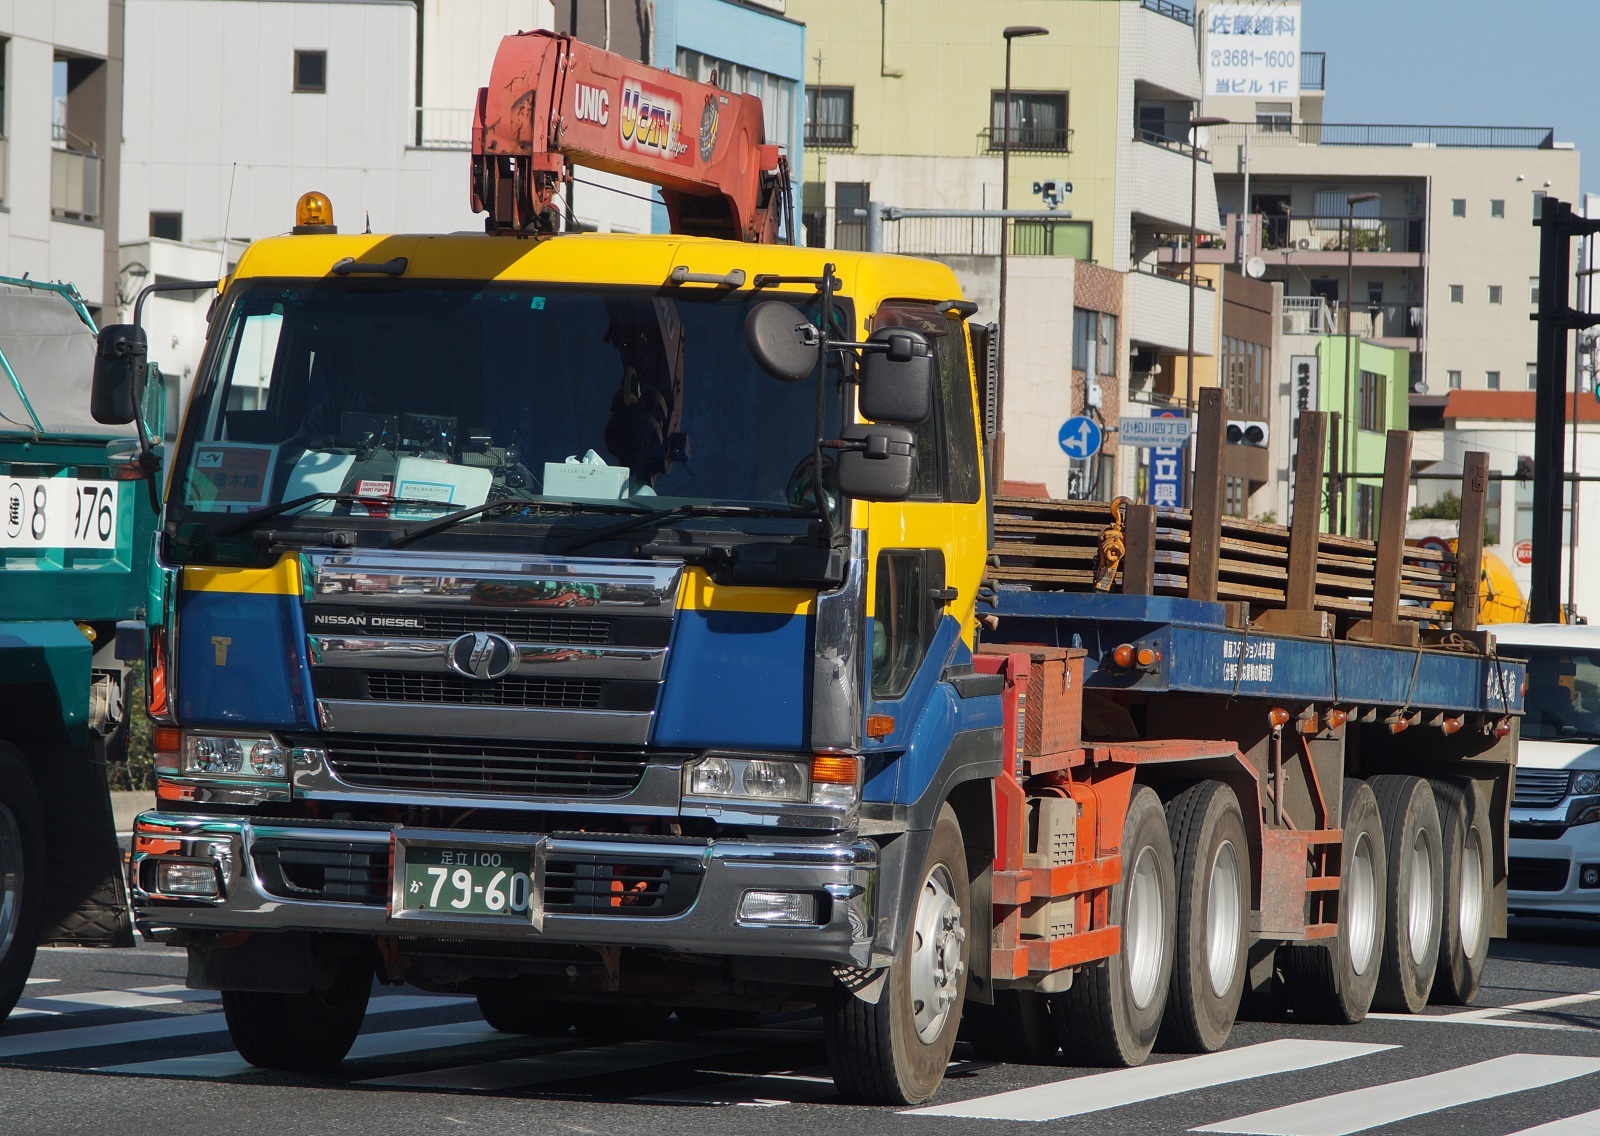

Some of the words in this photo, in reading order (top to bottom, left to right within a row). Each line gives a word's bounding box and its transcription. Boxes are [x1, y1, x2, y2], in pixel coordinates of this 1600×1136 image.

[1211, 14, 1296, 36] 佐藤歯科
[1223, 49, 1295, 68] 3681-1600
[1215, 79, 1263, 94] 当ビル
[1268, 80, 1289, 94] 1F
[574, 82, 610, 126] UNIC
[669, 136, 689, 159] Super
[1122, 421, 1187, 435] 小松川四丁目
[314, 615, 366, 626] NISSAN
[371, 617, 424, 629] DIESEL
[440, 851, 468, 866] 足立
[473, 852, 502, 868] 100
[409, 879, 424, 894] か
[427, 867, 530, 912] 79-60
